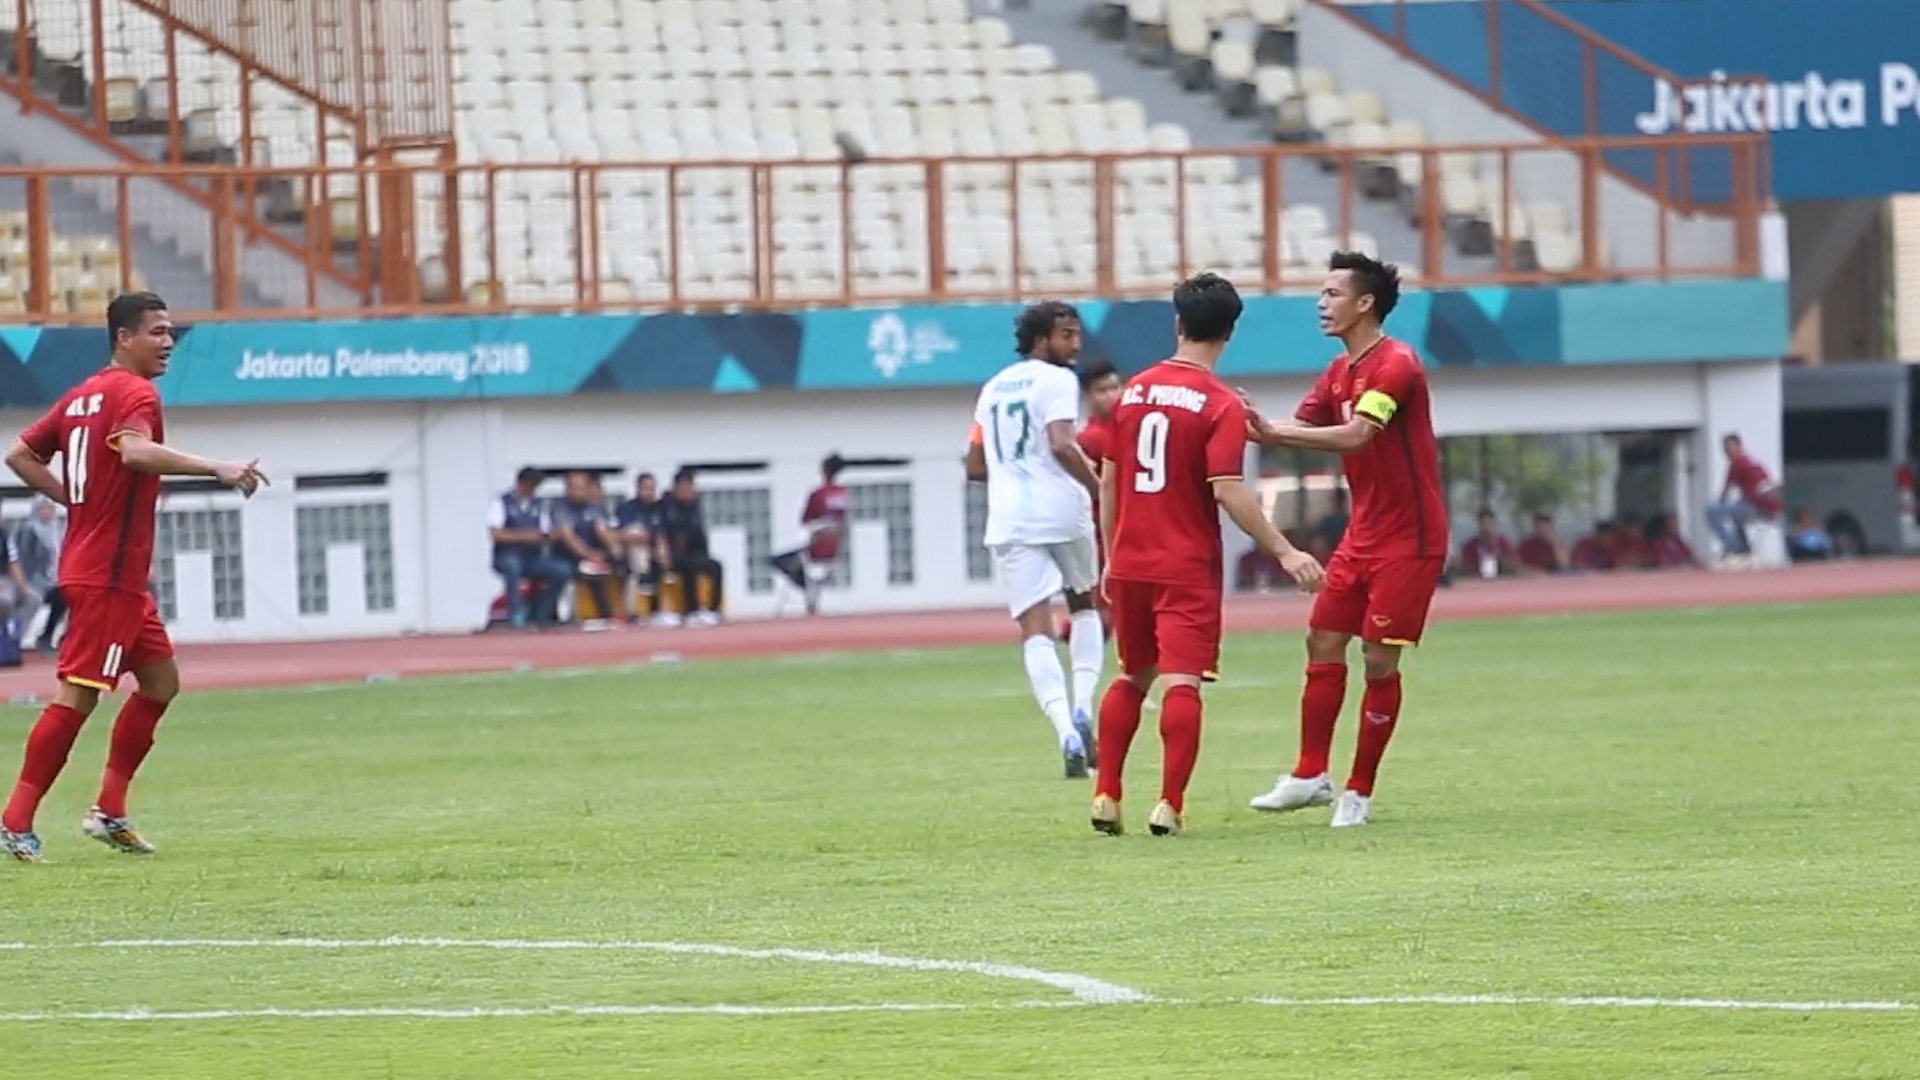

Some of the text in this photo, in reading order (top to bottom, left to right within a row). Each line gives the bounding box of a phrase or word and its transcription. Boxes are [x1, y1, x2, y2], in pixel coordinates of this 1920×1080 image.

[1635, 62, 1920, 134] Jakarta P
[236, 343, 530, 382] Jakarta Palembang 2018
[67, 425, 91, 505] 11
[990, 401, 1031, 464] 17
[1134, 411, 1171, 493] 9
[101, 642, 124, 678] 11
